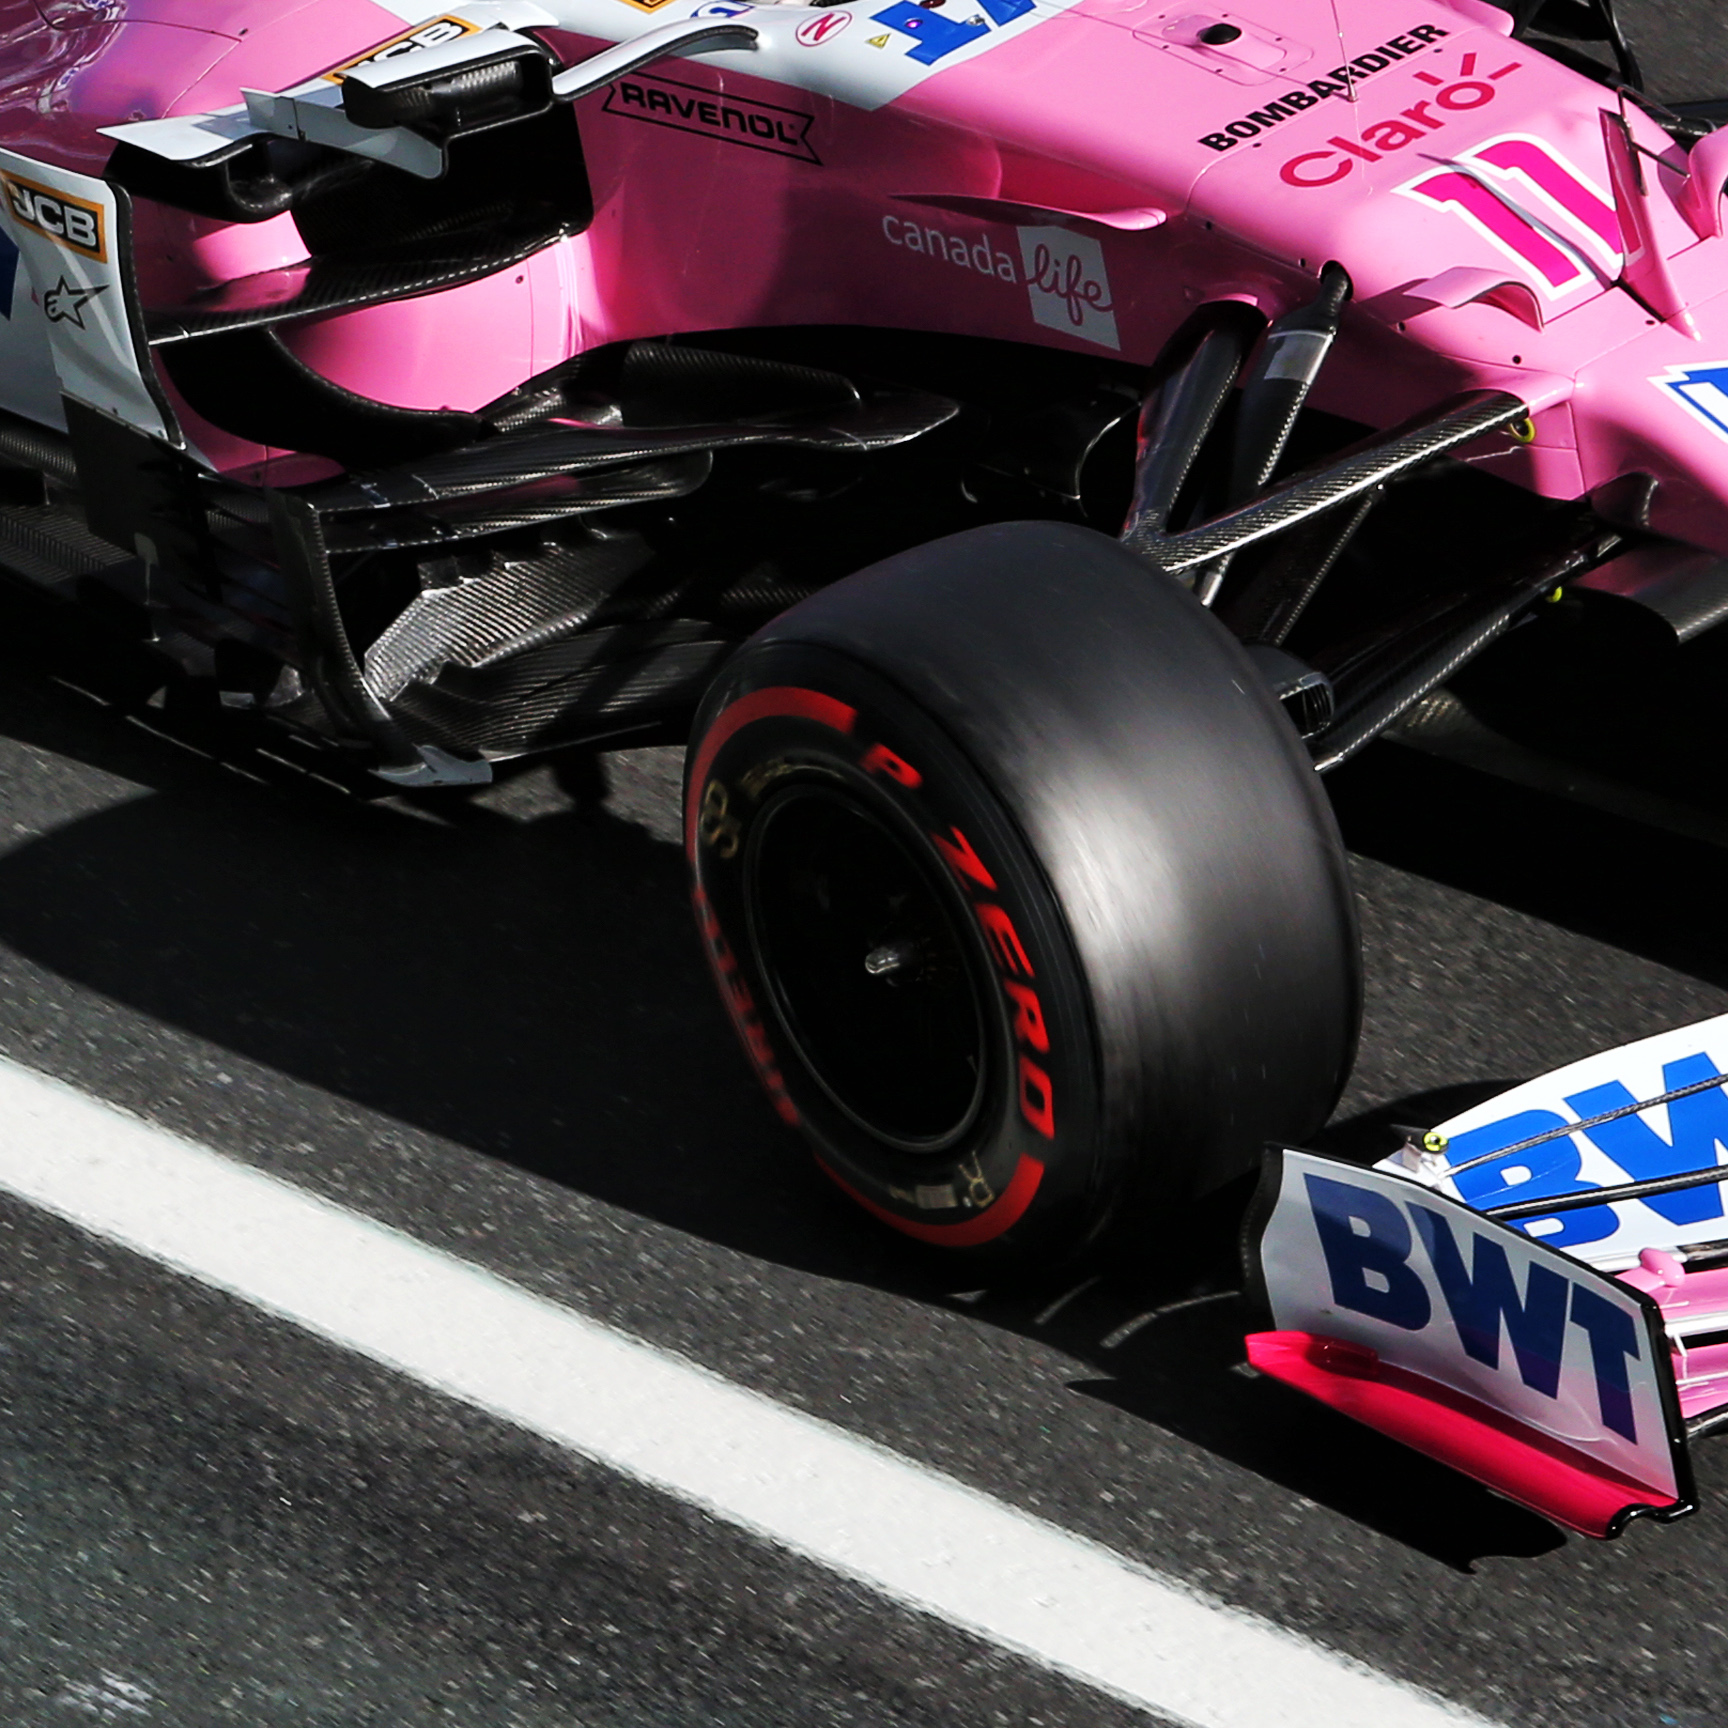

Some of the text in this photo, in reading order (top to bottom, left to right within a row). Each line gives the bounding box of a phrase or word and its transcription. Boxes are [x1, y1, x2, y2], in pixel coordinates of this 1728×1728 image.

[357, 22, 463, 67] CB
[1198, 23, 1451, 153] BOMBARDIER
[621, 80, 798, 146] RAVENOL
[1279, 53, 1522, 187] Claro
[12, 180, 98, 250] JCB
[882, 214, 1112, 327] canada life
[1392, 133, 1644, 301] 11
[862, 742, 923, 789] P
[929, 826, 1055, 1140] ZERO
[1303, 1173, 1640, 1445] BWT
